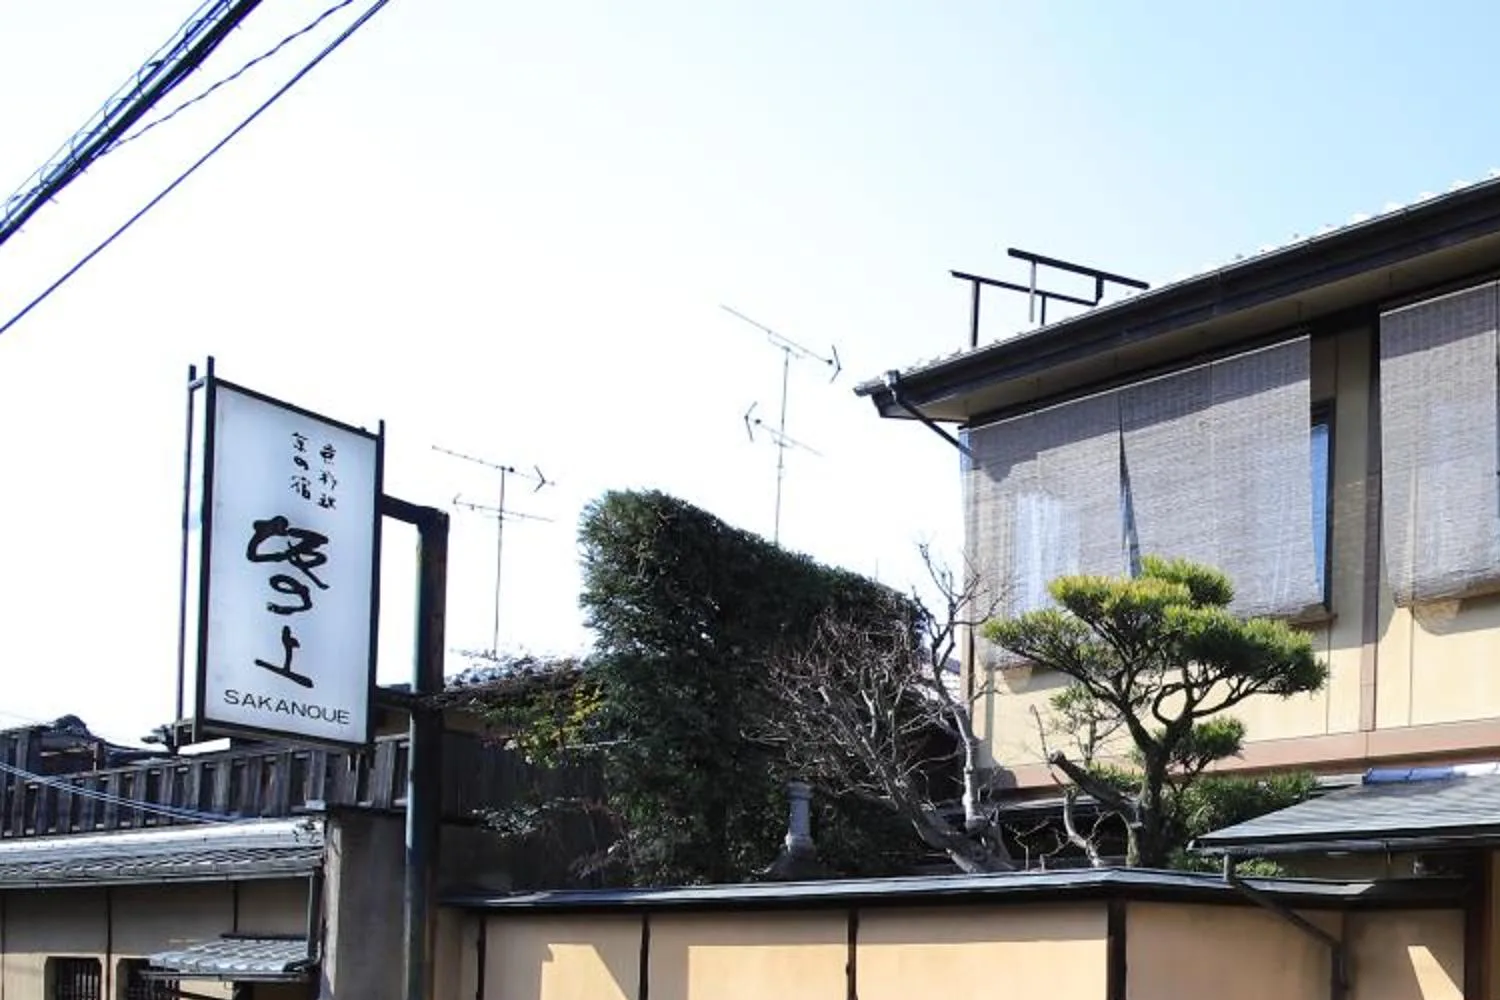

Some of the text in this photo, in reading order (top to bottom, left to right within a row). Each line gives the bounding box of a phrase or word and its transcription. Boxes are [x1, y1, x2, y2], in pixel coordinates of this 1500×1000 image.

[246, 515, 330, 689] 坂の上
[223, 689, 350, 725] SAKANOUE
